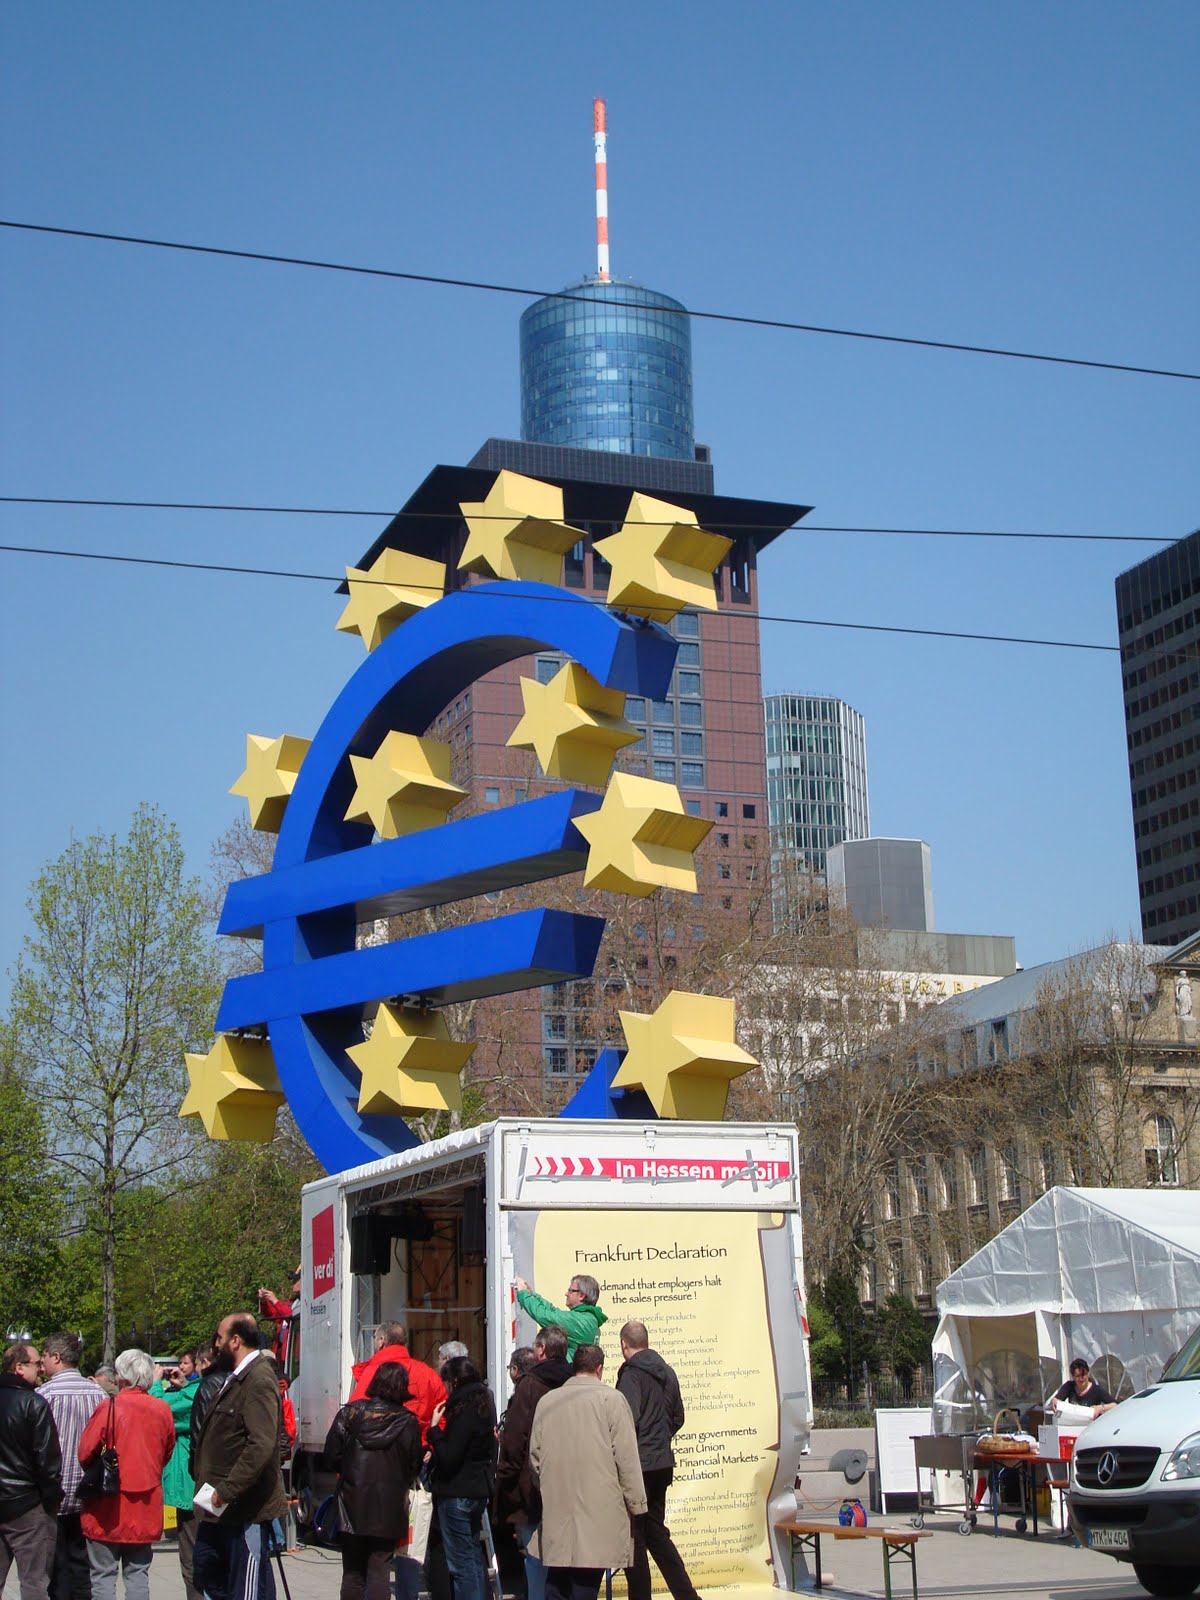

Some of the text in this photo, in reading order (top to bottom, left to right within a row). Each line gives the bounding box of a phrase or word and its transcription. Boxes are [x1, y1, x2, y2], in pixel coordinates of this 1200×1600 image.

[616, 1161, 636, 1178] In
[642, 1161, 714, 1180] Hessen
[575, 1242, 728, 1263] Frankfurt Declaration
[600, 1274, 722, 1293] demand that employers halt
[612, 1292, 627, 1304] the
[629, 1291, 652, 1303] sales
[654, 1294, 692, 1307] pressure
[639, 1312, 664, 1325] specific
[666, 1312, 696, 1325] products
[658, 1326, 683, 1336] targets
[687, 1335, 704, 1344] work
[705, 1334, 718, 1343] and
[659, 1347, 715, 1357] stant supervision
[680, 1358, 700, 1367] better
[702, 1357, 723, 1366] advice
[694, 1370, 704, 1379] for
[705, 1369, 721, 1378] bank
[723, 1368, 760, 1380] employees
[691, 1379, 712, 1389] advice
[700, 1392, 711, 1401] the
[712, 1390, 734, 1401] salary
[724, 1399, 756, 1413] products
[672, 1427, 758, 1446] pean governments
[695, 1444, 725, 1454] Union
[679, 1453, 720, 1468] Financial
[722, 1452, 759, 1465] Markets
[671, 1468, 719, 1487] peculation
[689, 1492, 715, 1503] national
[716, 1490, 729, 1500] and
[692, 1503, 705, 1513] with
[670, 1516, 696, 1524] services
[689, 1527, 700, 1535] for
[701, 1524, 718, 1536] risky
[685, 1537, 720, 1549] essentially
